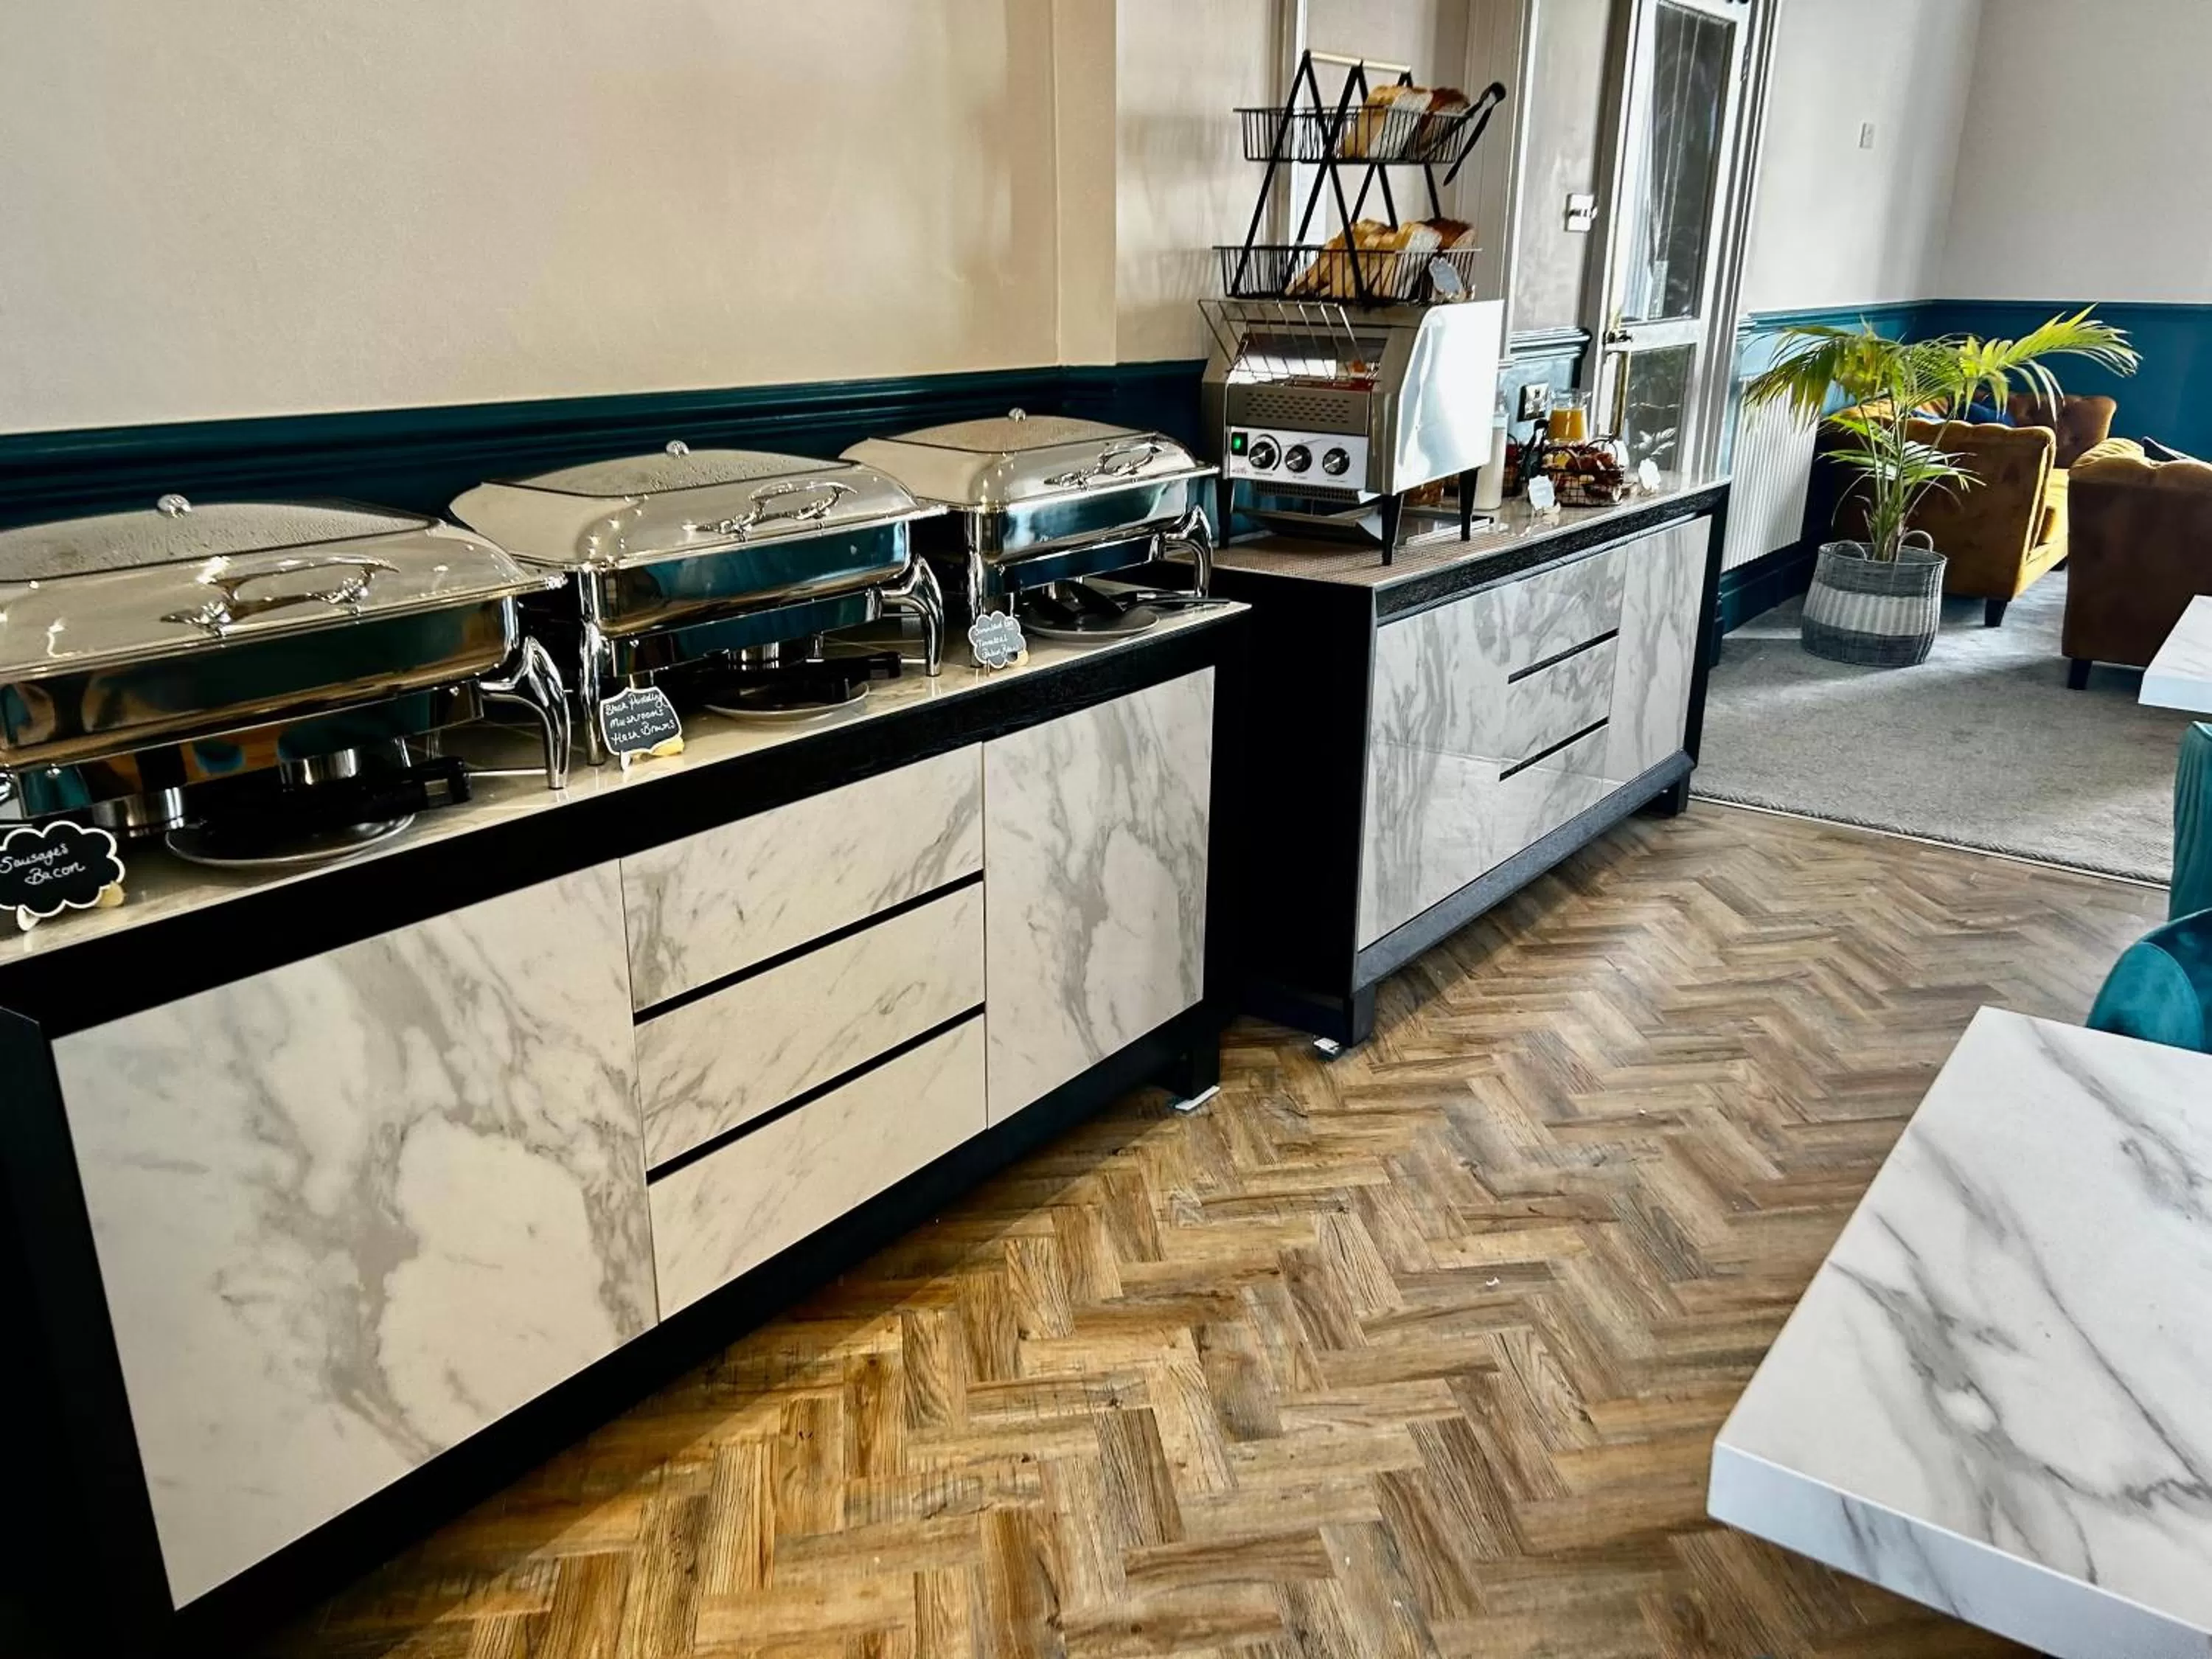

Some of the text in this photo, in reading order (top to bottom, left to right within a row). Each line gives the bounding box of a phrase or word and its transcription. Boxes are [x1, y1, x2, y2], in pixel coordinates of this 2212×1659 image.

[611, 731, 641, 745] Hash
[0, 843, 69, 874] Sausages
[24, 861, 86, 885] Bacon
